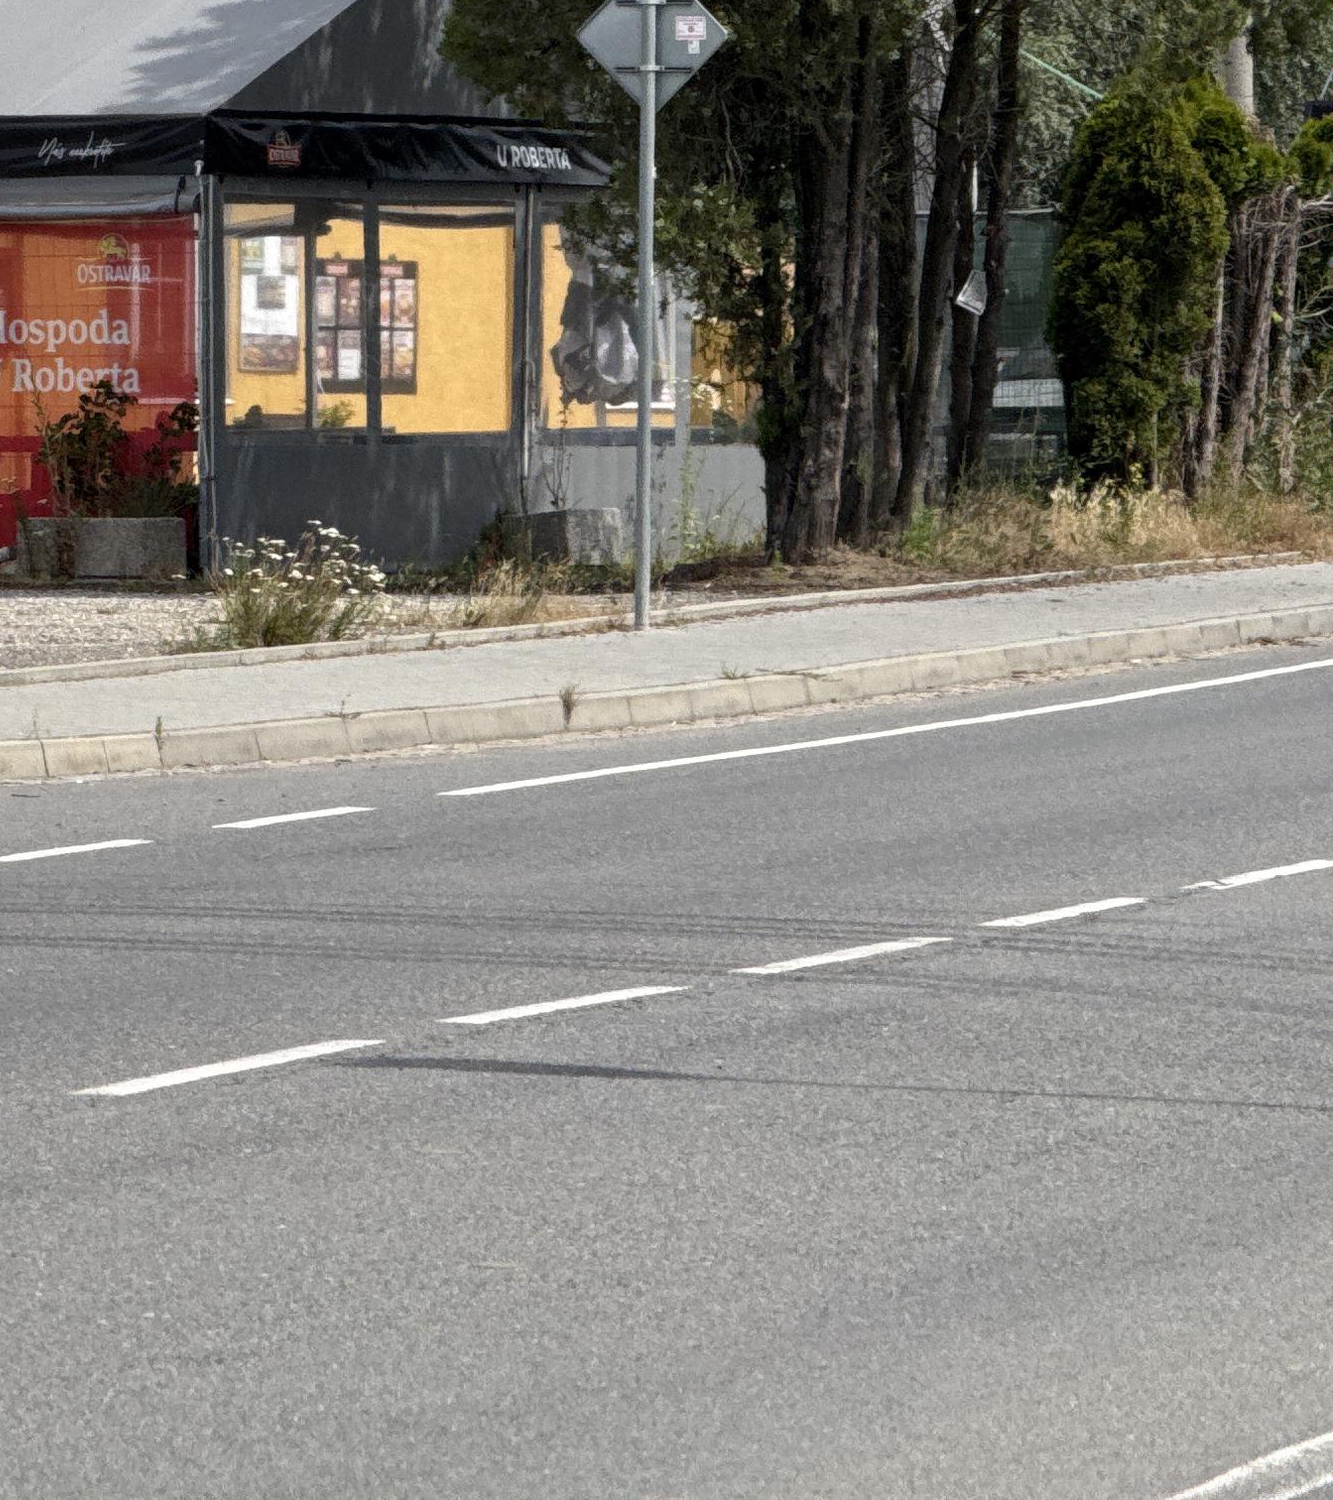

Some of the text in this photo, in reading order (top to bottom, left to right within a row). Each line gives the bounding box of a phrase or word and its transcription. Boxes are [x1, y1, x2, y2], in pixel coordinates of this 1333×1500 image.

[496, 144, 572, 170] U ROBERTA
[77, 264, 151, 284] OSTRAVAR
[11, 357, 141, 394] Roberta
